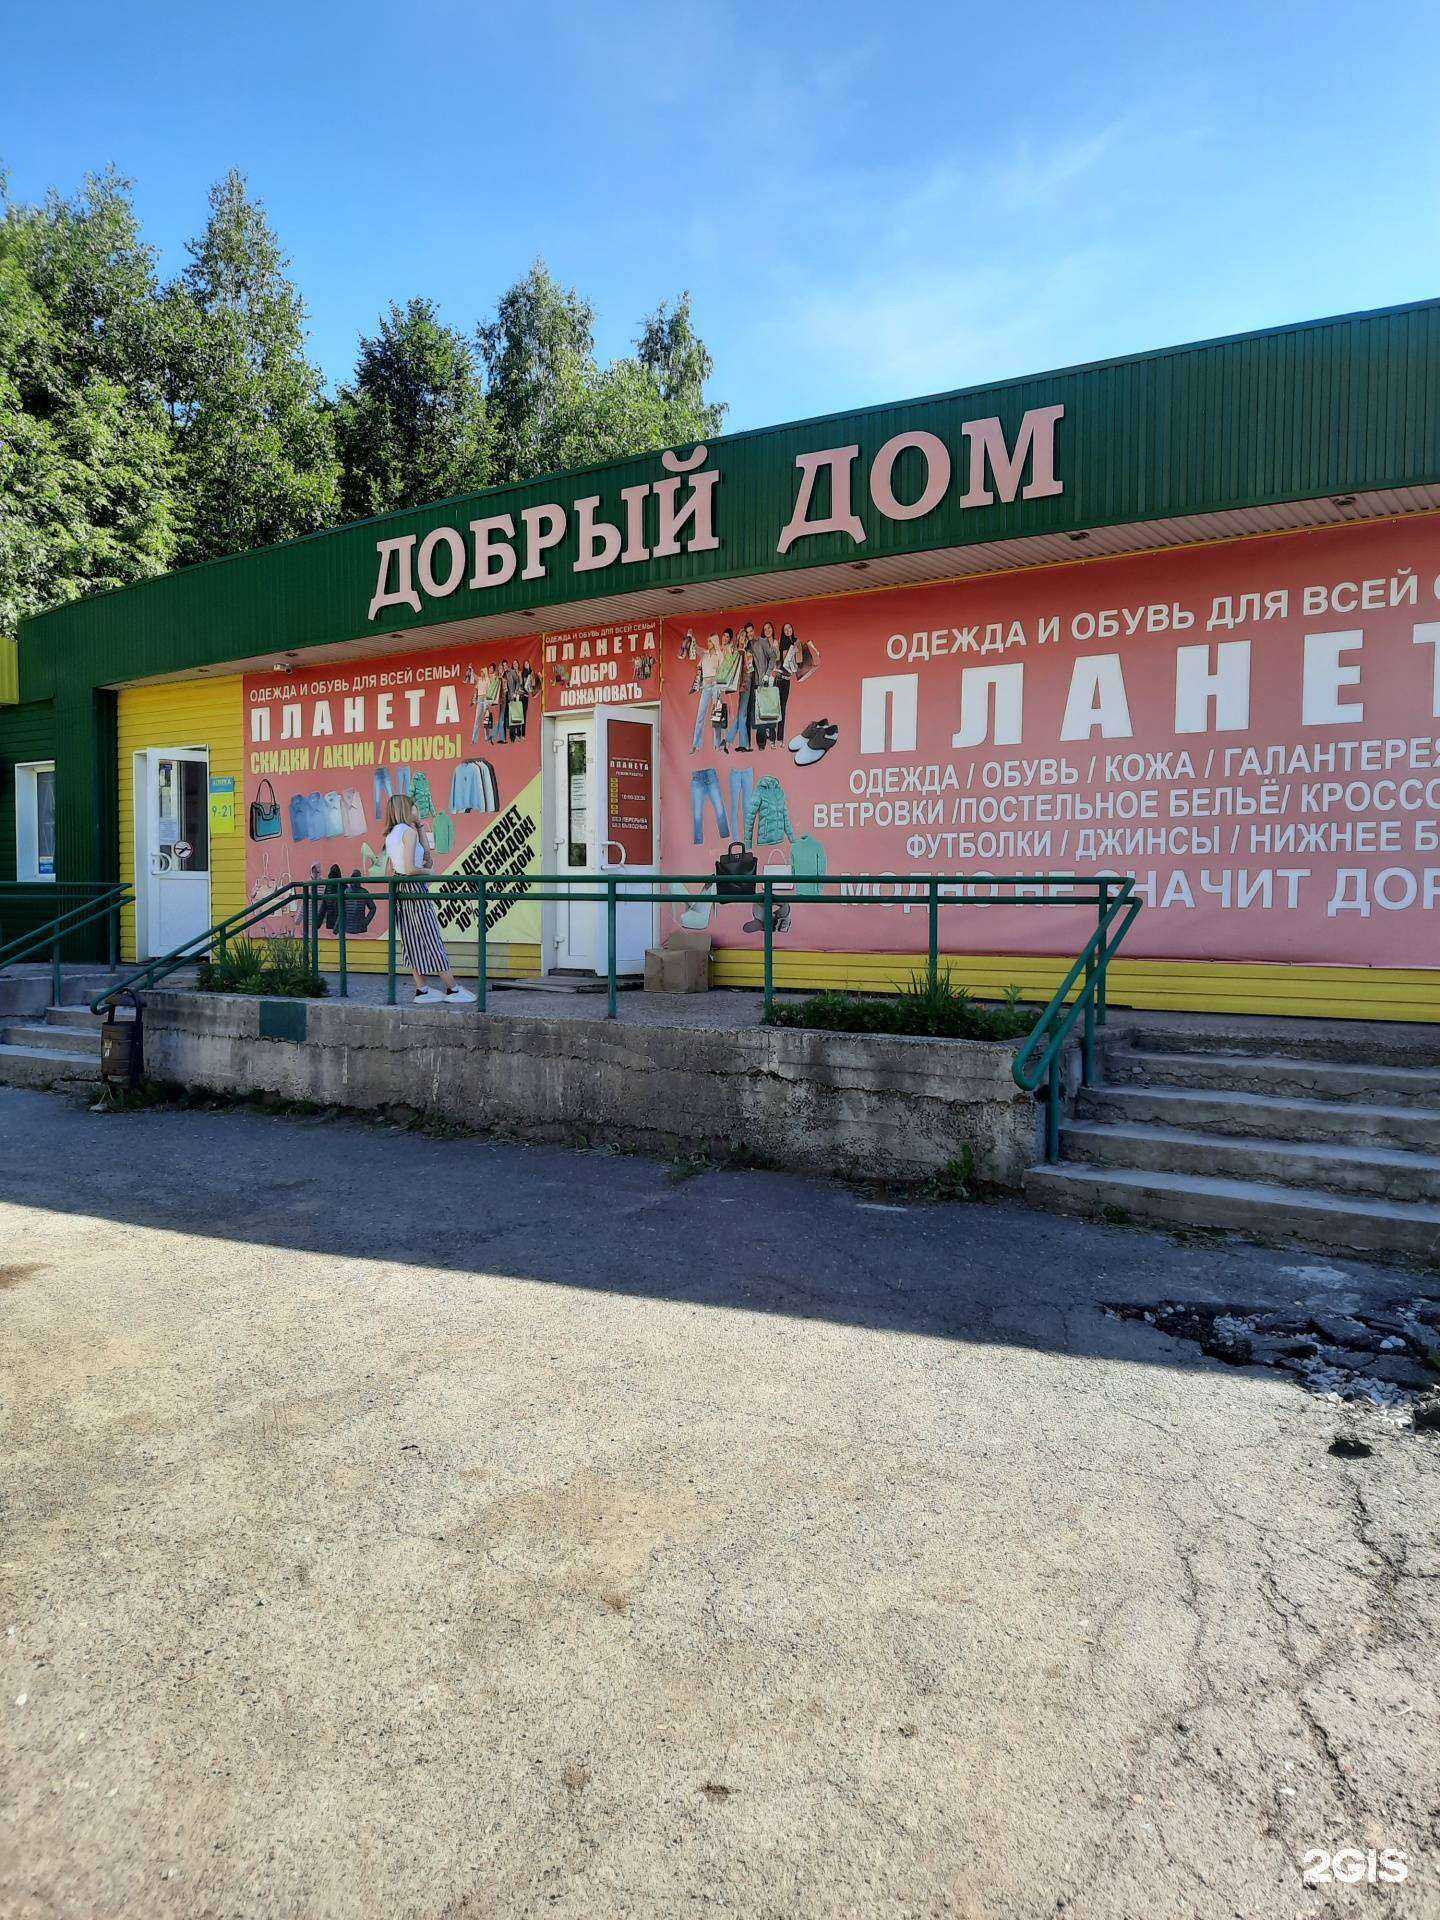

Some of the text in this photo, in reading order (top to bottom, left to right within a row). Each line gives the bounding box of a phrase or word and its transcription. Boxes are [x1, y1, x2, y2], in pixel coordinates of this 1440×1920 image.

[367, 404, 1064, 620] ДОБРЫЙ ДОМ
[886, 621, 1027, 662] ОДЕЖДА
[1038, 617, 1060, 644] И
[1071, 602, 1195, 641] ОБУВЬ
[1206, 589, 1289, 631] ДЛЯ
[1303, 567, 1418, 616] ВСЕЙ
[545, 632, 656, 663] ПЛАНЕТА
[250, 663, 460, 702] ОДЕЖДА И ОБУВЬ ДЛЯ ВСЕЙ СЕМЬИ
[560, 682, 643, 707] ПОЖАЛОВАТЬ
[569, 660, 618, 688] ДОБРО
[250, 685, 460, 743] ПЛАНЕТА
[250, 747, 310, 775] СКИДКИ
[323, 742, 375, 770] АКЦИИ
[390, 734, 462, 763] БОНУСЫ
[849, 764, 959, 798] ОДЕЖДА
[982, 757, 1079, 788] ОБУВЬ
[1105, 750, 1196, 784] КОЖА
[813, 799, 944, 829] ВЕТРОВКИ
[461, 804, 522, 878] ДЕЙСТВУЕТ
[485, 815, 537, 877] СКИДОК!
[906, 830, 1051, 859] ФУТБОЛКИ
[1075, 824, 1220, 861] ДЖИНСЫ
[1250, 820, 1402, 854] НИЖНЕЕ
